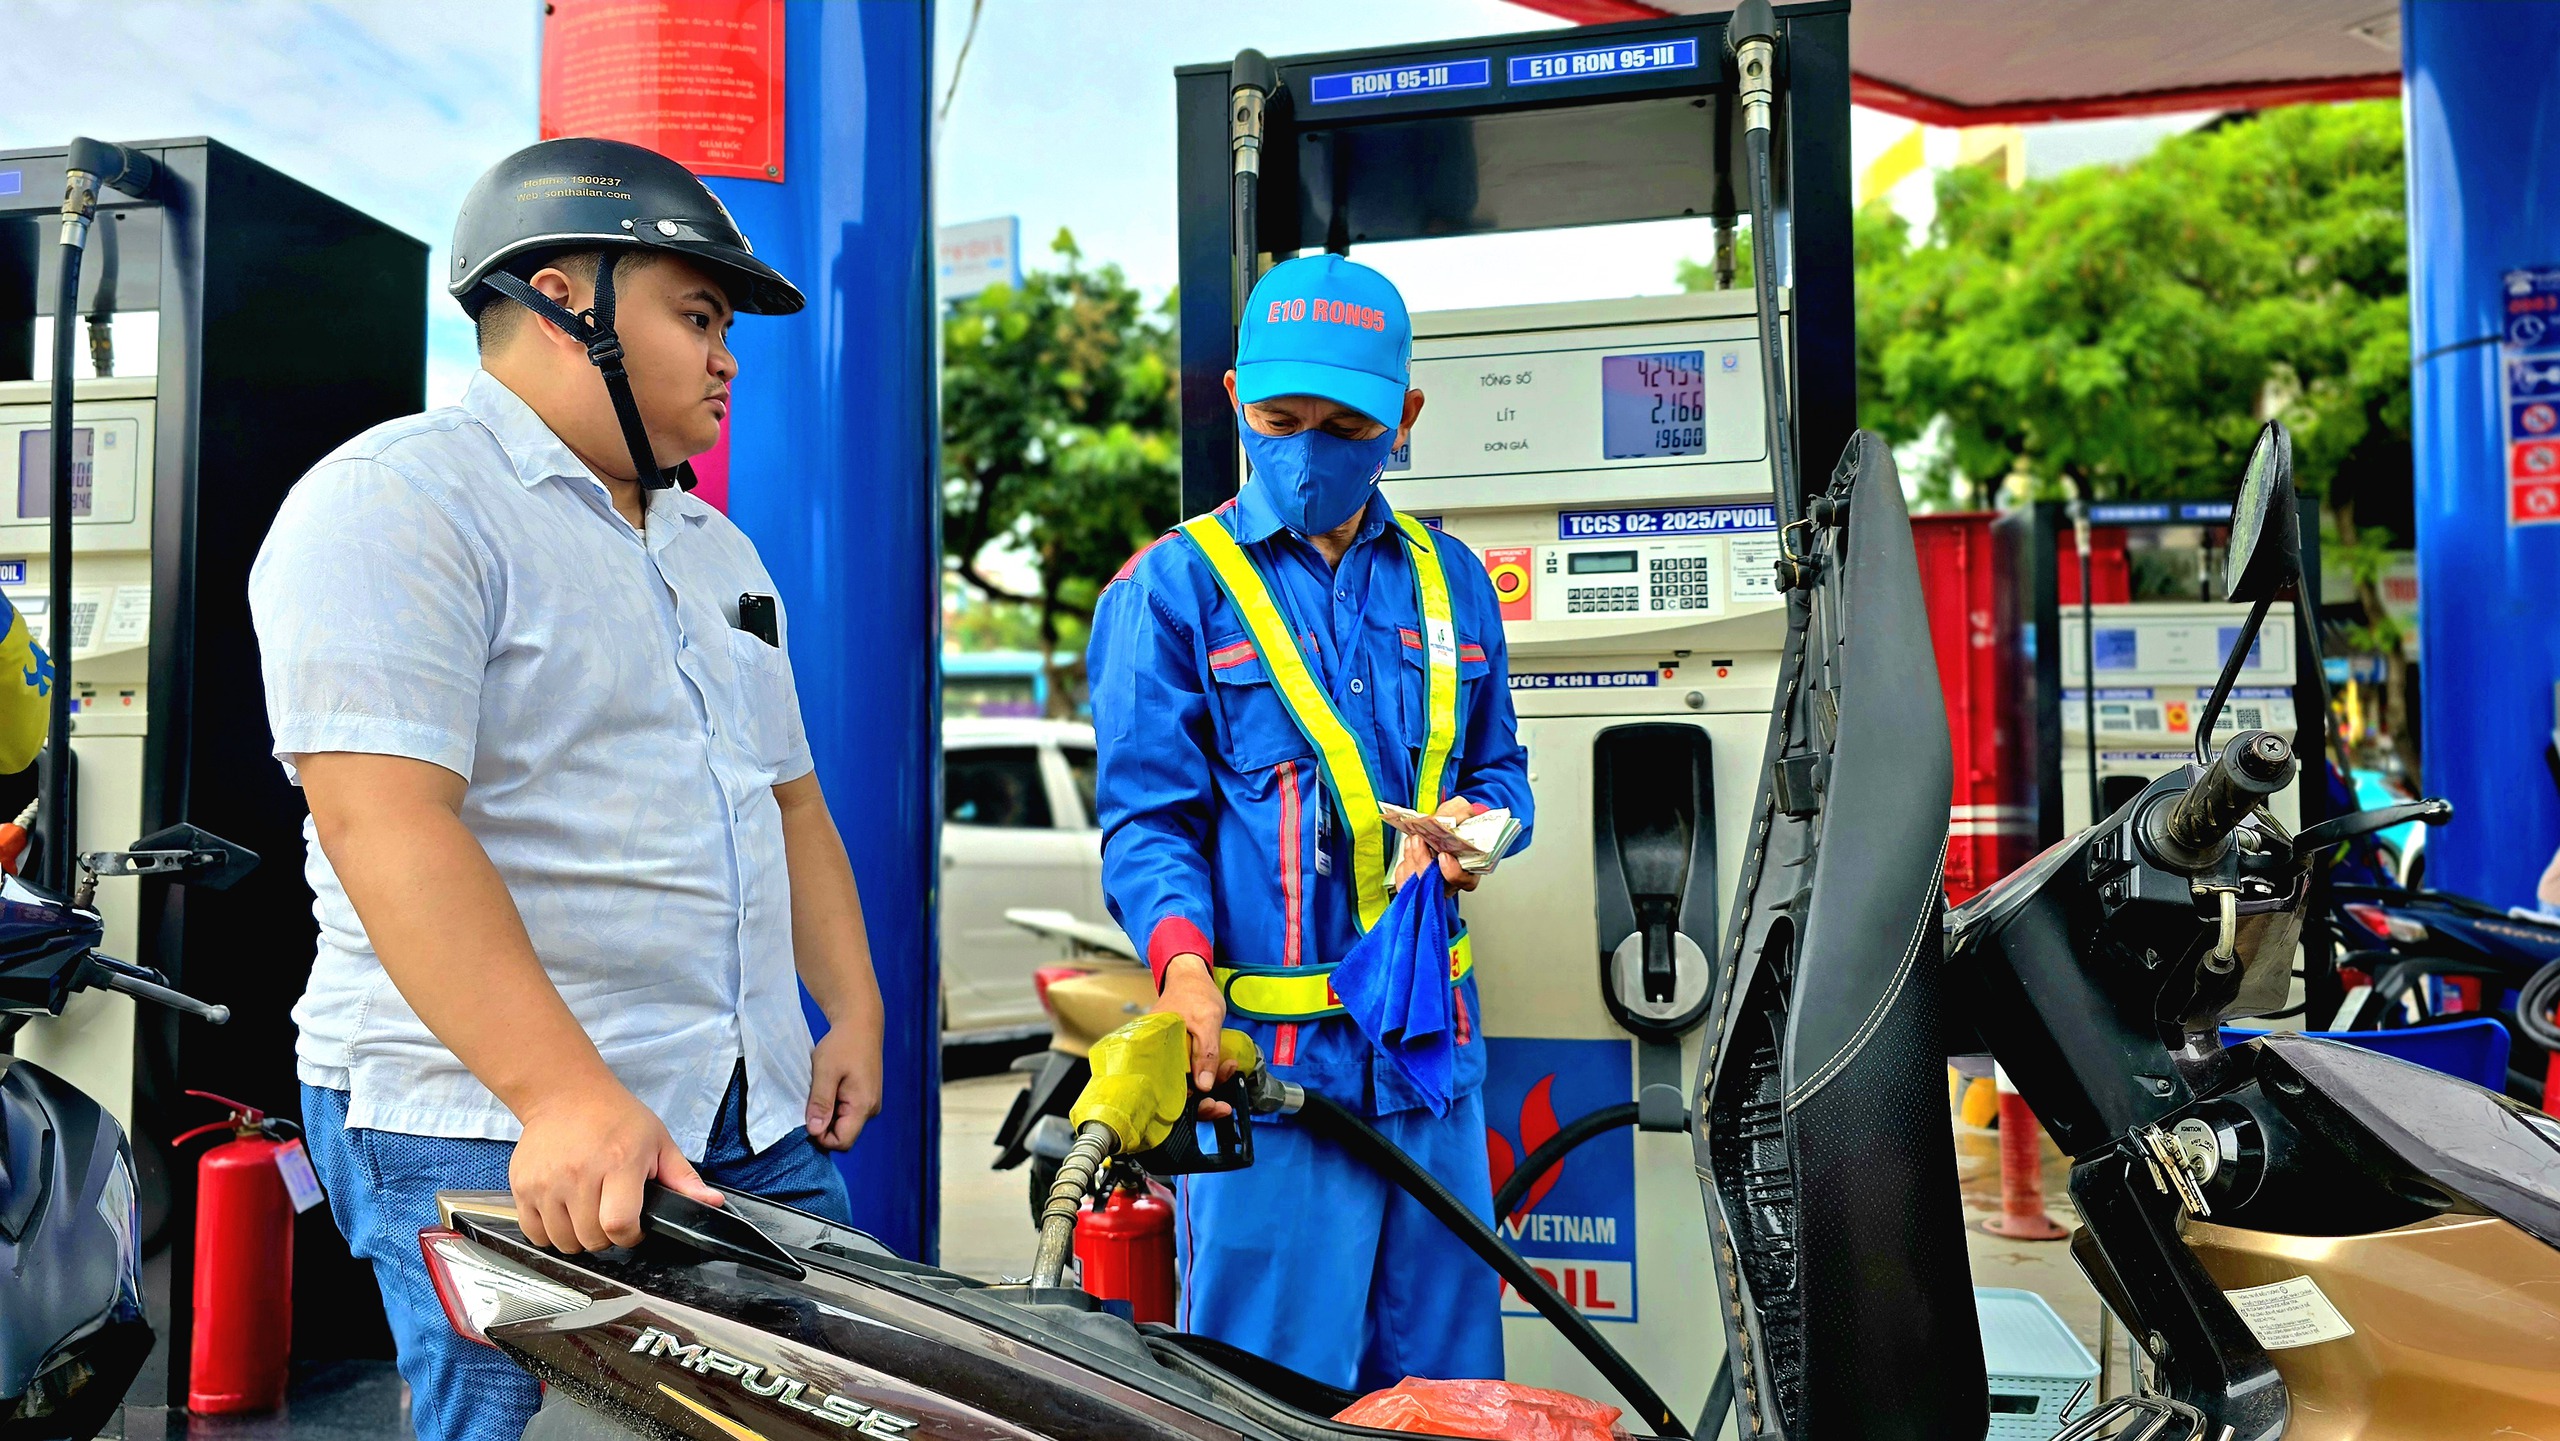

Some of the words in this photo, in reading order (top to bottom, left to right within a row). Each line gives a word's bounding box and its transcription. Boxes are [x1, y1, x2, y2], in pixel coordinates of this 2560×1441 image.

[1530, 58, 1567, 77] E10
[1572, 53, 1616, 75] RON
[1620, 46, 1675, 69] 95-III
[1351, 72, 1393, 95] RON
[1397, 67, 1449, 89] 95-III
[570, 176, 622, 187] 1900237
[544, 188, 632, 201] sonthailan.com
[1267, 299, 1306, 324] E10
[1312, 299, 1386, 332] RON95
[1516, 371, 1532, 384] SỐ
[1638, 355, 1702, 388] 42454
[1497, 407, 1516, 421] LÍT
[1484, 442, 1508, 451] ĐƠN
[1510, 439, 1529, 450] GIÁ
[1655, 427, 1703, 449] 19600
[1570, 517, 1621, 534] TCCS
[1626, 515, 1657, 531] 02:
[1662, 508, 1776, 530] 2025/PVOIL
[1653, 561, 1660, 569] 7
[1668, 560, 1674, 568] 8
[1682, 560, 1689, 568] 9
[0, 565, 20, 581] OIL
[1653, 574, 1660, 582] 4
[1668, 574, 1675, 582] 5
[1682, 573, 1689, 581] 6
[1654, 587, 1660, 595] 1
[1668, 586, 1675, 594] 2
[1683, 586, 1689, 594] 3
[1654, 601, 1660, 609] 0
[1668, 600, 1676, 608] C
[1507, 675, 1550, 688] ƯỚC
[1554, 674, 1592, 686] KHI
[1597, 673, 1648, 686] BƠM
[629, 1326, 919, 1441] IMPULSE
